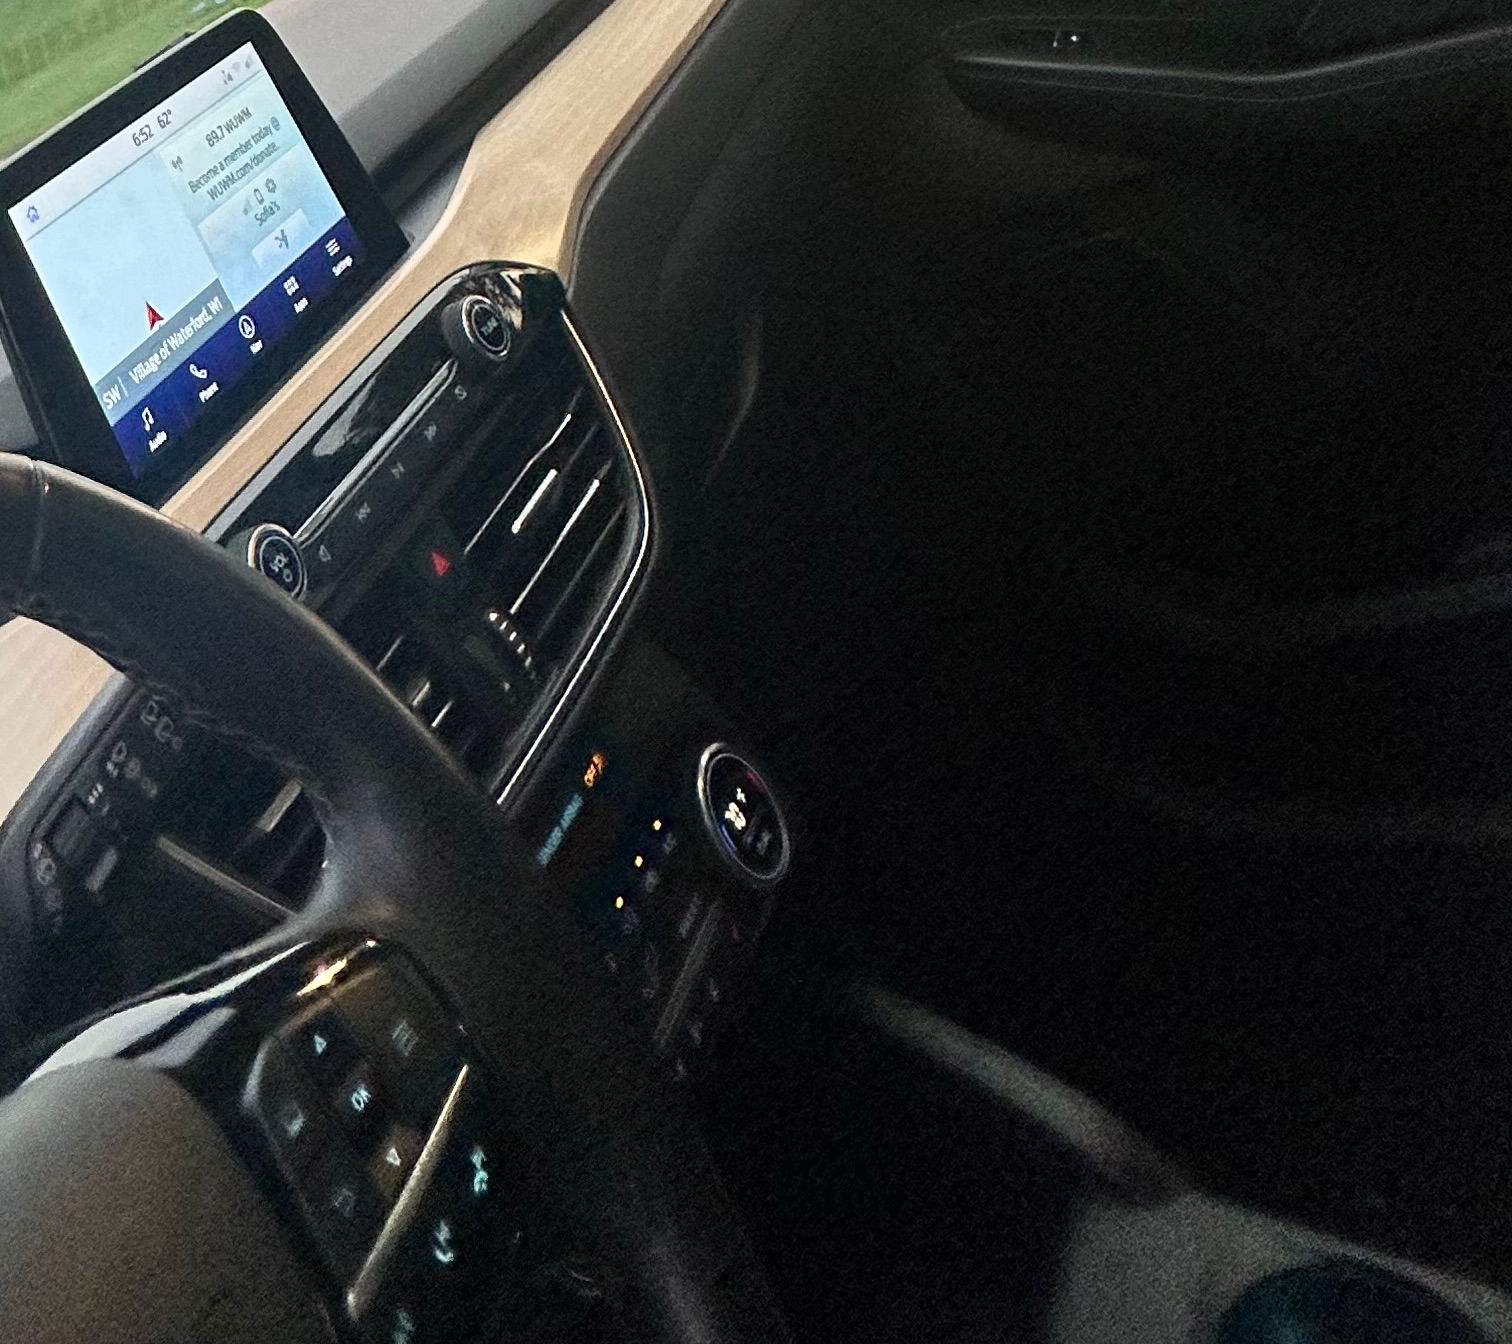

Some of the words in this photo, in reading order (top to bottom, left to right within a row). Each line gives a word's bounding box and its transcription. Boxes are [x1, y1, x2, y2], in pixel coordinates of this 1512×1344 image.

[132, 124, 153, 147] 6:52
[205, 124, 226, 148] 89.7
[224, 107, 253, 136] WUWM
[187, 167, 220, 194] Become
[223, 138, 255, 169] member
[250, 127, 274, 153] today
[102, 385, 123, 411] SW
[129, 356, 162, 385] Village
[207, 295, 224, 318] WI
